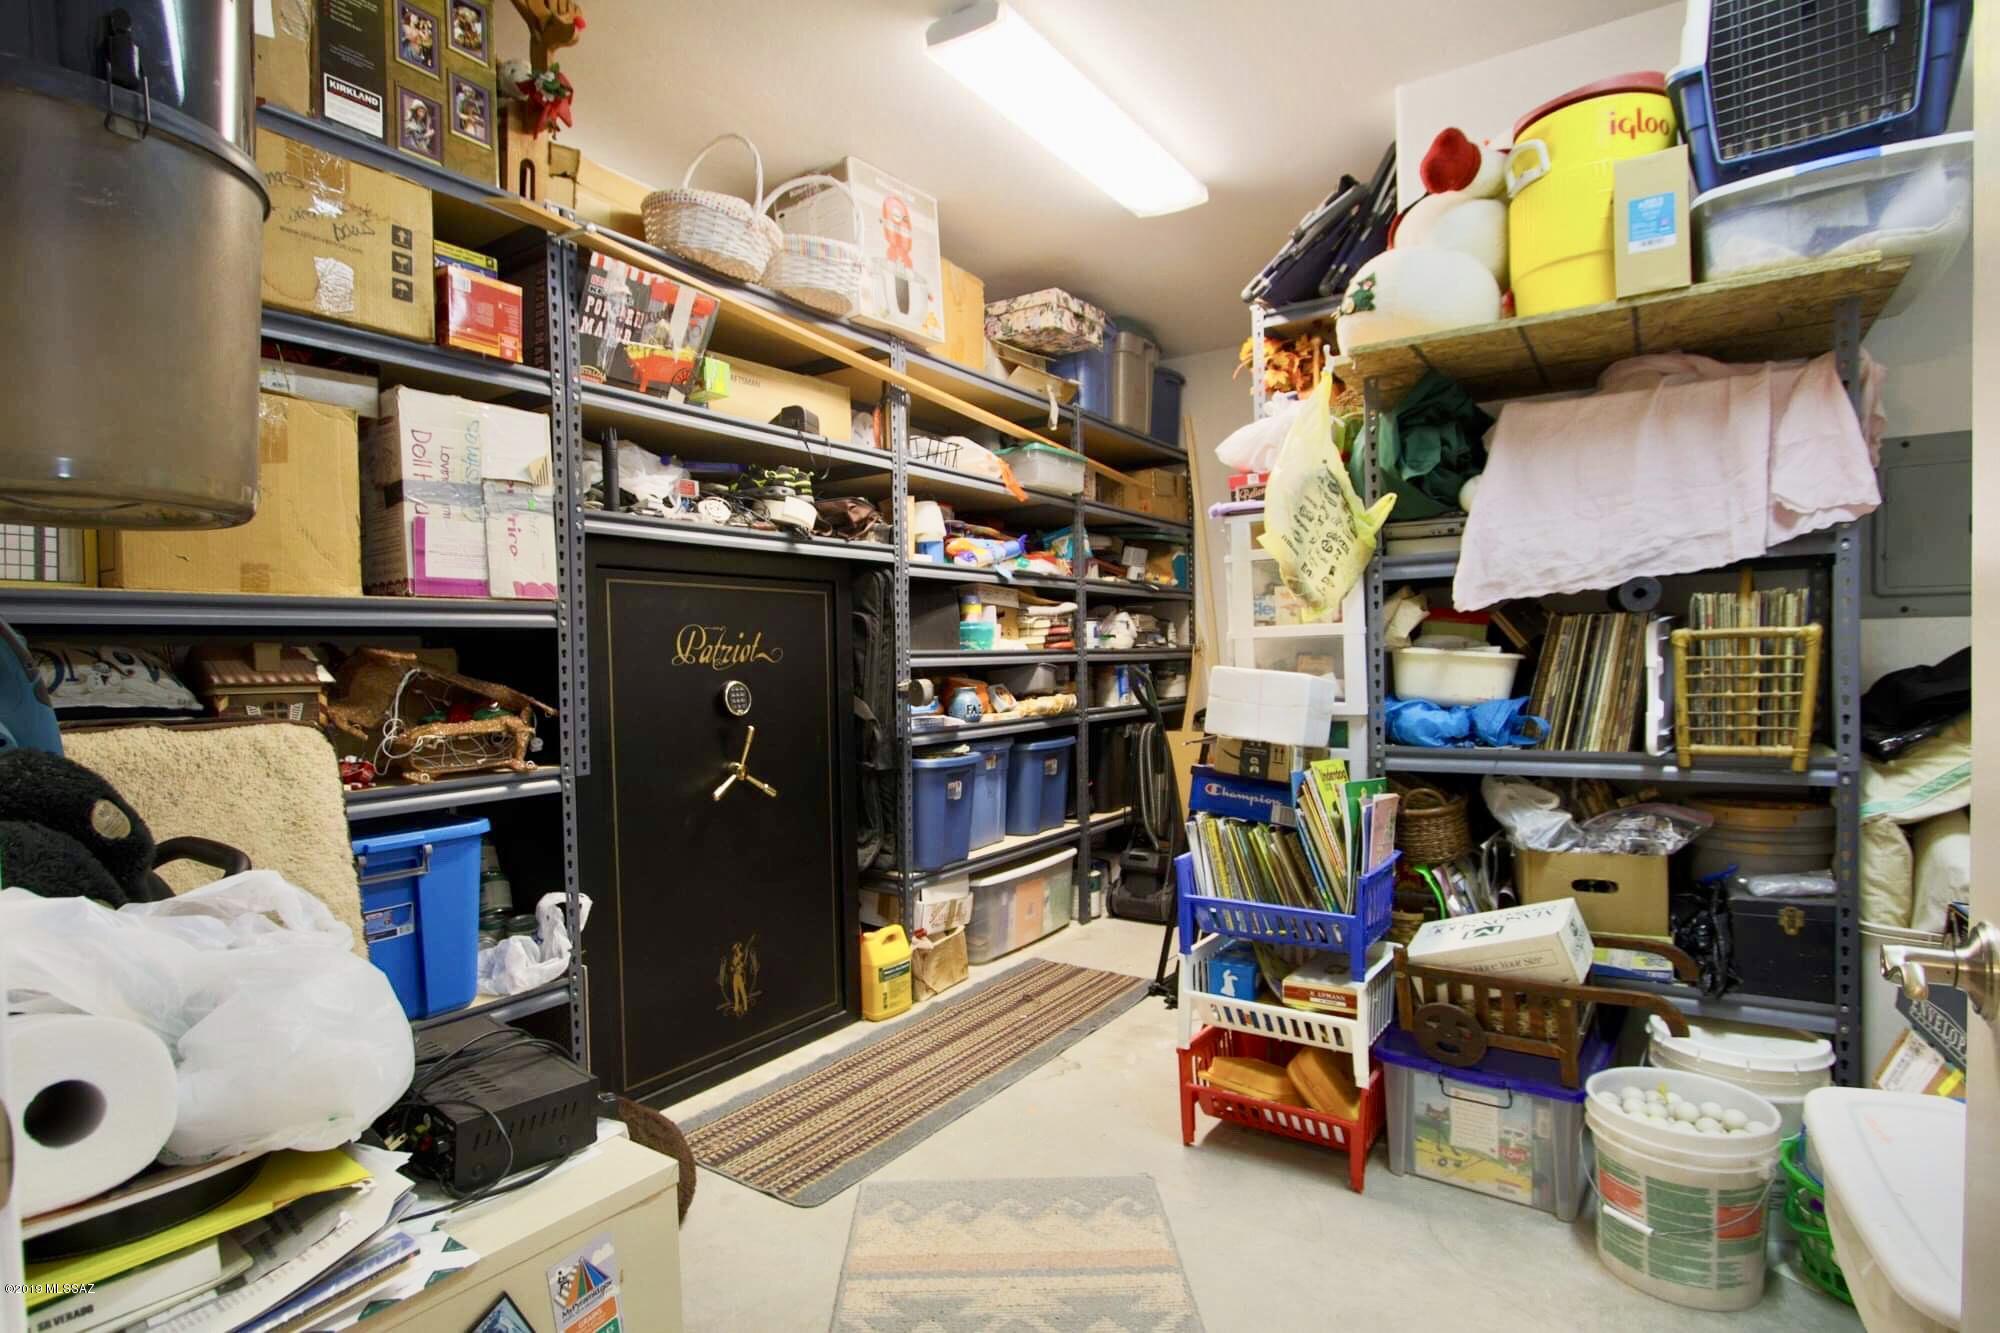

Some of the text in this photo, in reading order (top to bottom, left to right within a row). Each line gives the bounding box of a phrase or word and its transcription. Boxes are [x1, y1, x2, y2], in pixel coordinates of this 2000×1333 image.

[328, 79, 379, 107] KIRKLAND
[1609, 107, 1670, 140] igloo
[672, 624, 783, 671] Patriot
[1205, 783, 1283, 807] Champion
